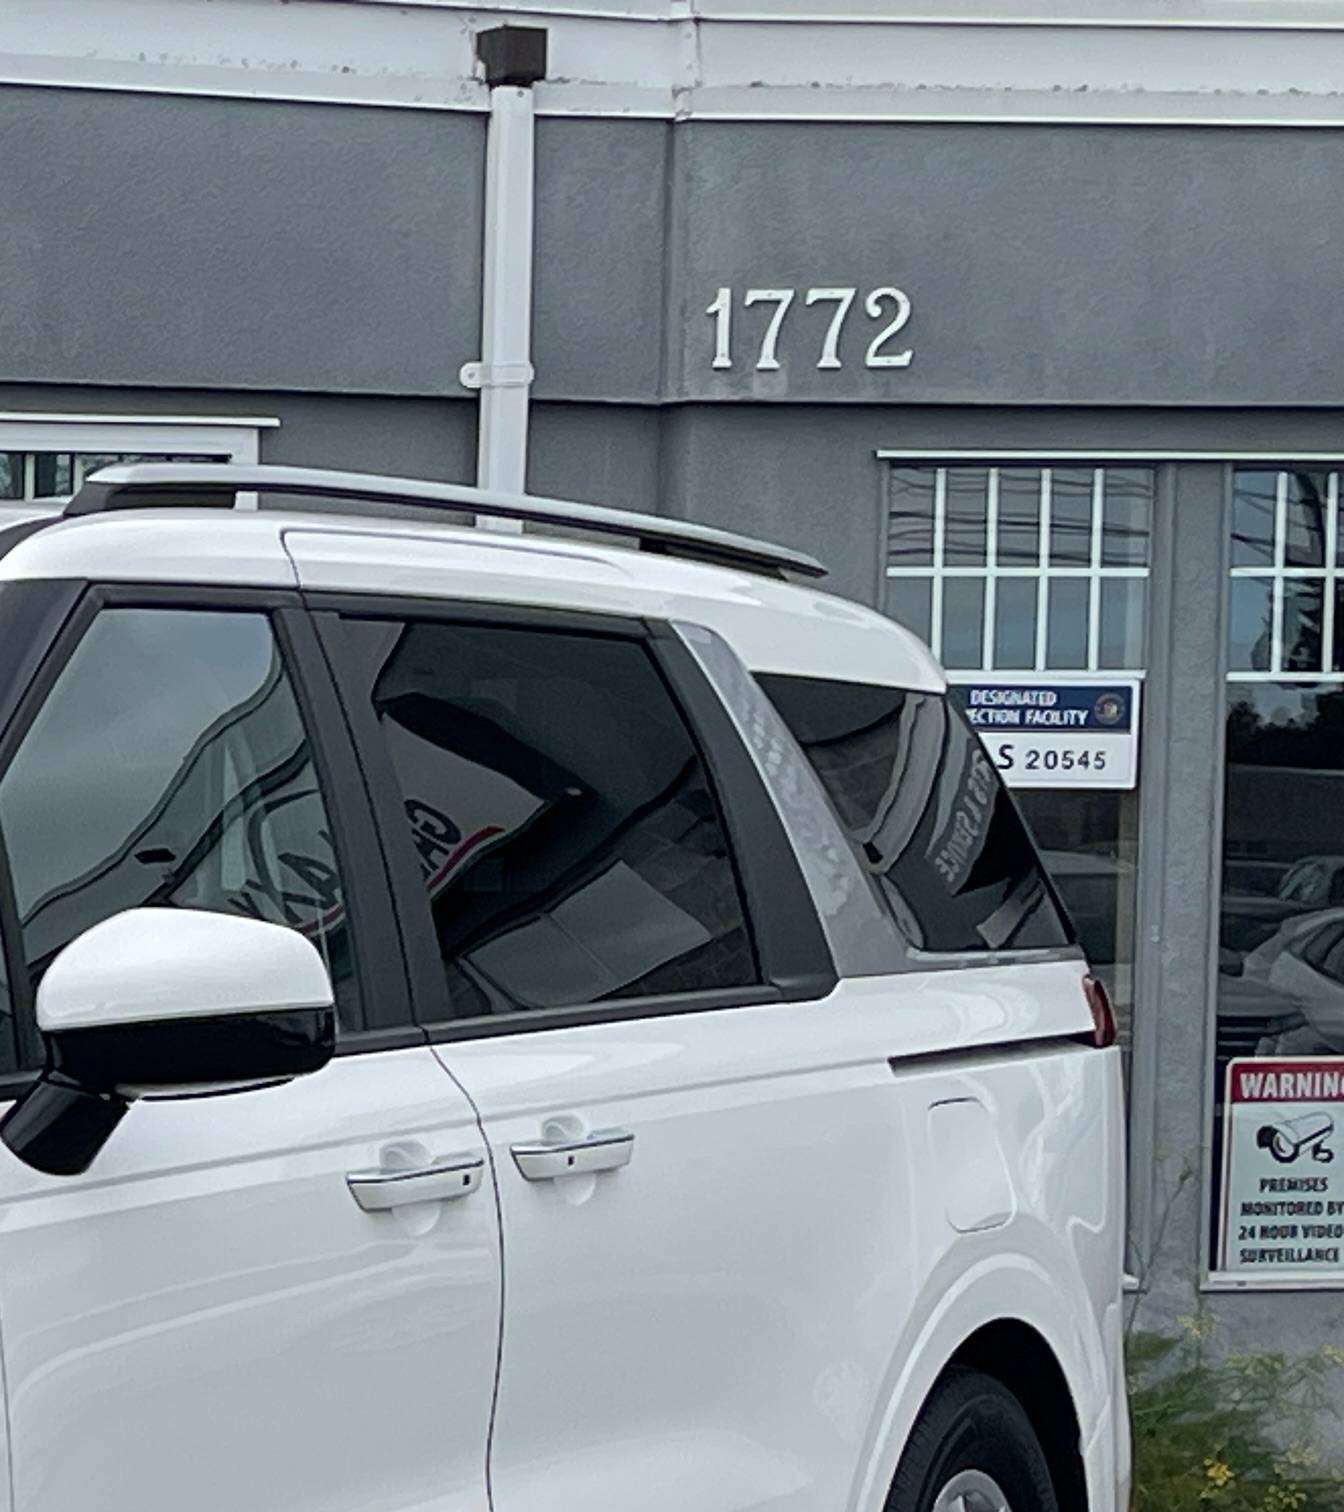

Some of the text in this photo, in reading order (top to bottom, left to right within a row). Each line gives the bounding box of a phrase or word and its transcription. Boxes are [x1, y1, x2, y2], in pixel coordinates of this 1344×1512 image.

[705, 286, 914, 371] 1772
[969, 689, 1058, 707] DESIGNATED
[964, 708, 1089, 726] ECTION FACILITY
[1024, 749, 1107, 771] 20545
[1239, 1072, 1344, 1099] WARNIN
[1258, 1177, 1329, 1193] PREMISES
[1239, 1201, 1325, 1217] MONITORED
[1238, 1223, 1344, 1241] 24 HOUR VIDEO
[1239, 1247, 1340, 1264] SURVEILLANCE
